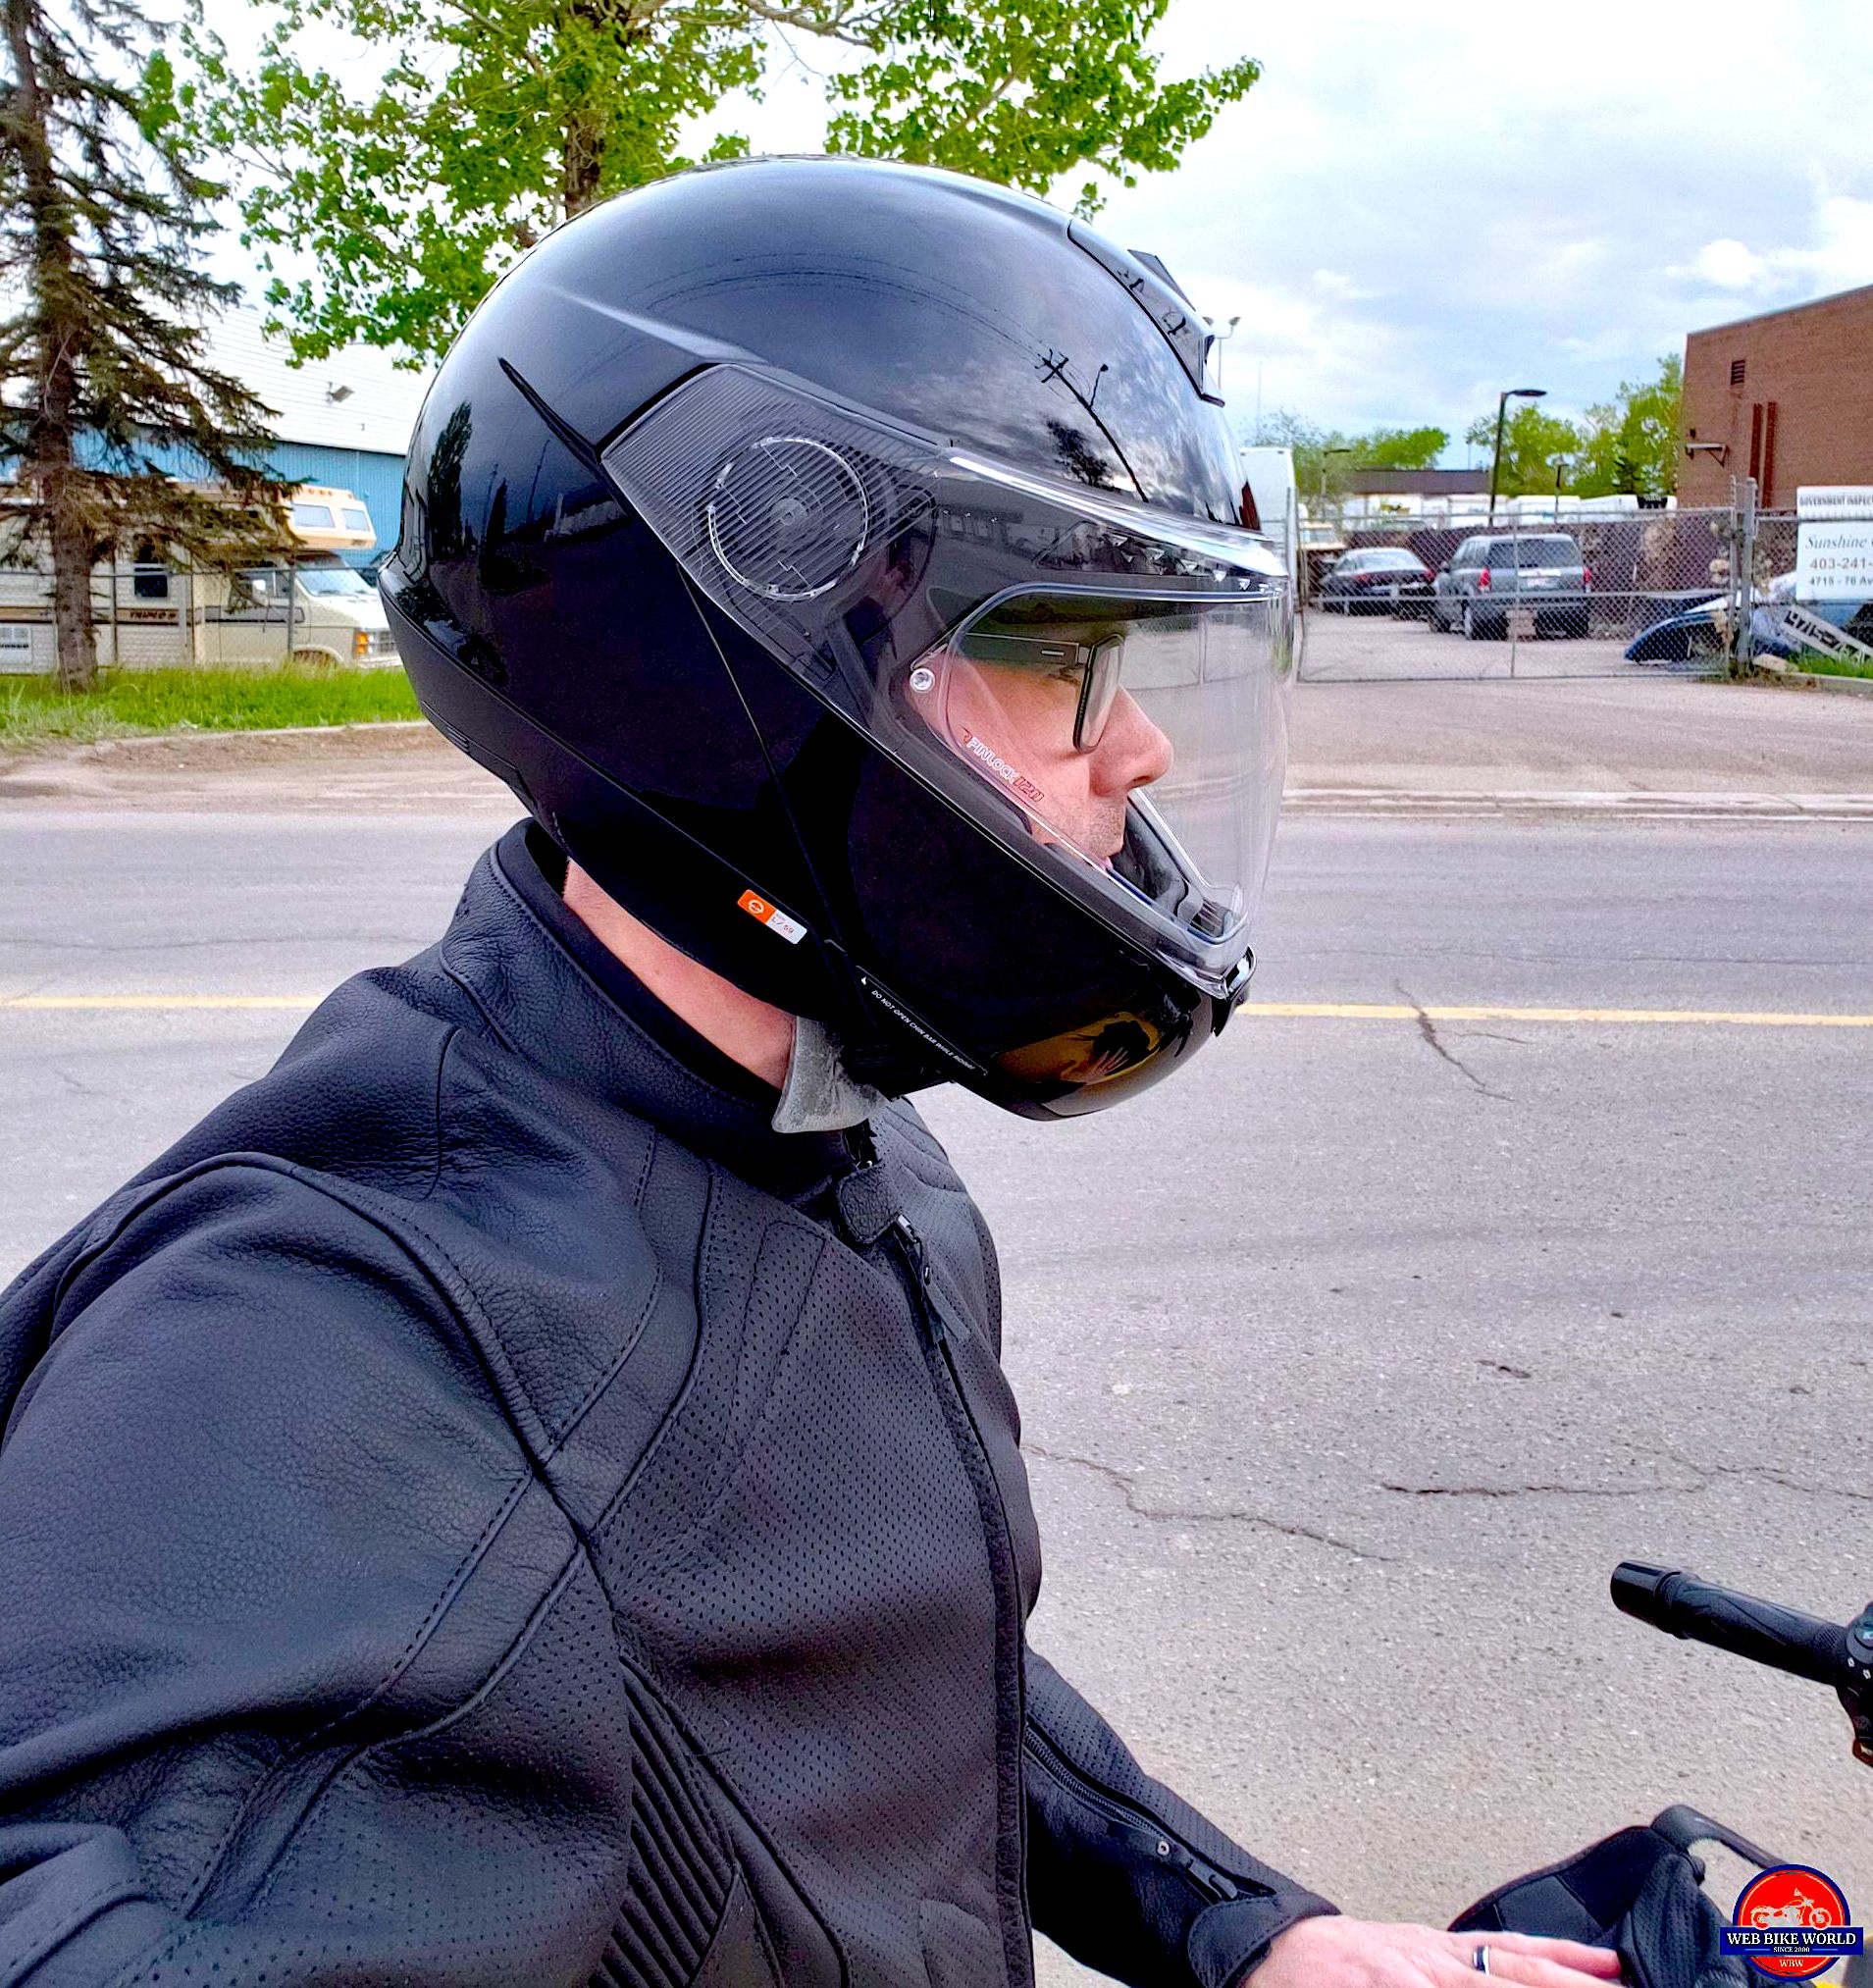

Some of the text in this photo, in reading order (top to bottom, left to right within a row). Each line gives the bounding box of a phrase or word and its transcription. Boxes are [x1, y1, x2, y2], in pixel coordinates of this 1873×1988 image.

[1847, 494, 1873, 505] INSPEC
[1805, 534, 1867, 549] Sunshine
[966, 737, 1045, 802] PINLOCK 120
[871, 990, 882, 999] DO
[881, 998, 895, 1009] NOT
[894, 1009, 911, 1023] OPEN
[910, 1022, 925, 1034] CHIN
[923, 1033, 937, 1044] BAR
[935, 1042, 954, 1056] WHILE
